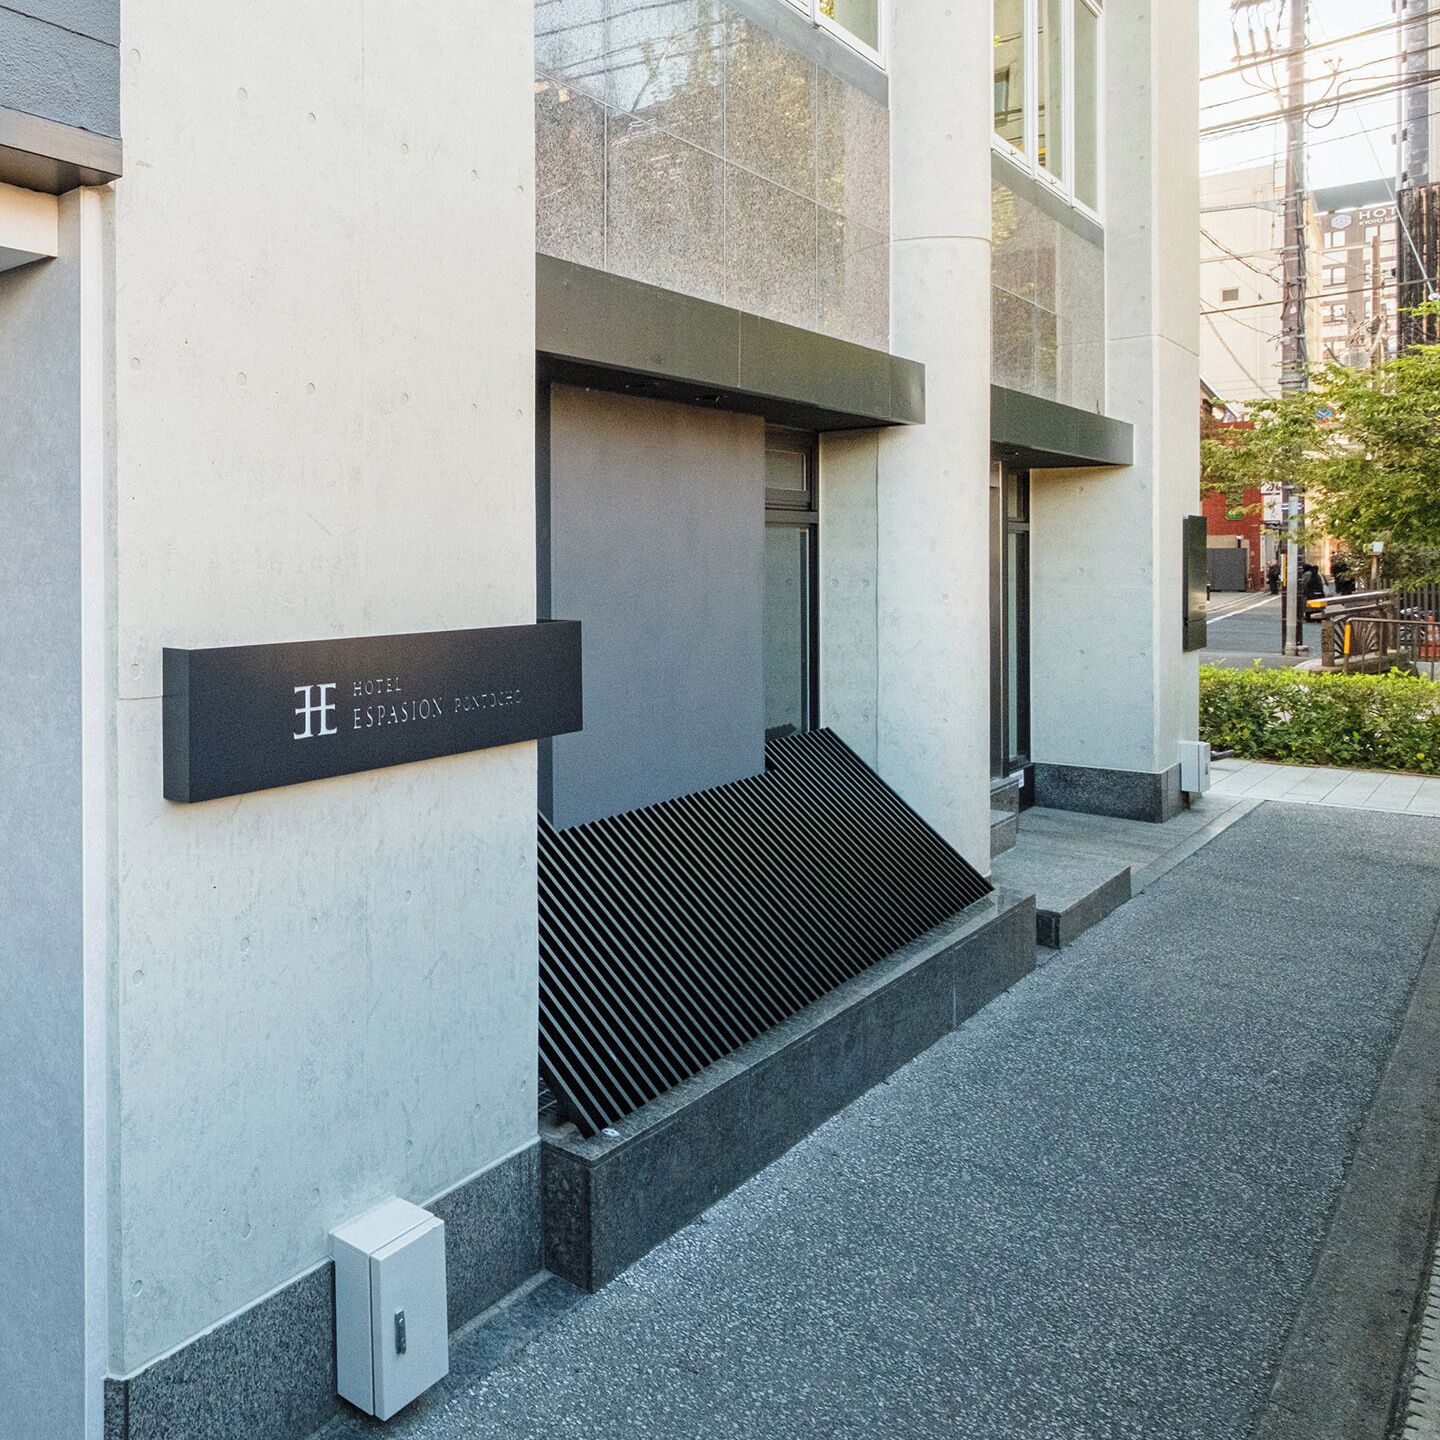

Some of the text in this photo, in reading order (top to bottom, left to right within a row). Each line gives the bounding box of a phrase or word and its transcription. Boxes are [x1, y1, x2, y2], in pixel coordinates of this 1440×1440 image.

[353, 677, 402, 697] HOTEL
[353, 689, 522, 729] ESPASION PONTOCHO
